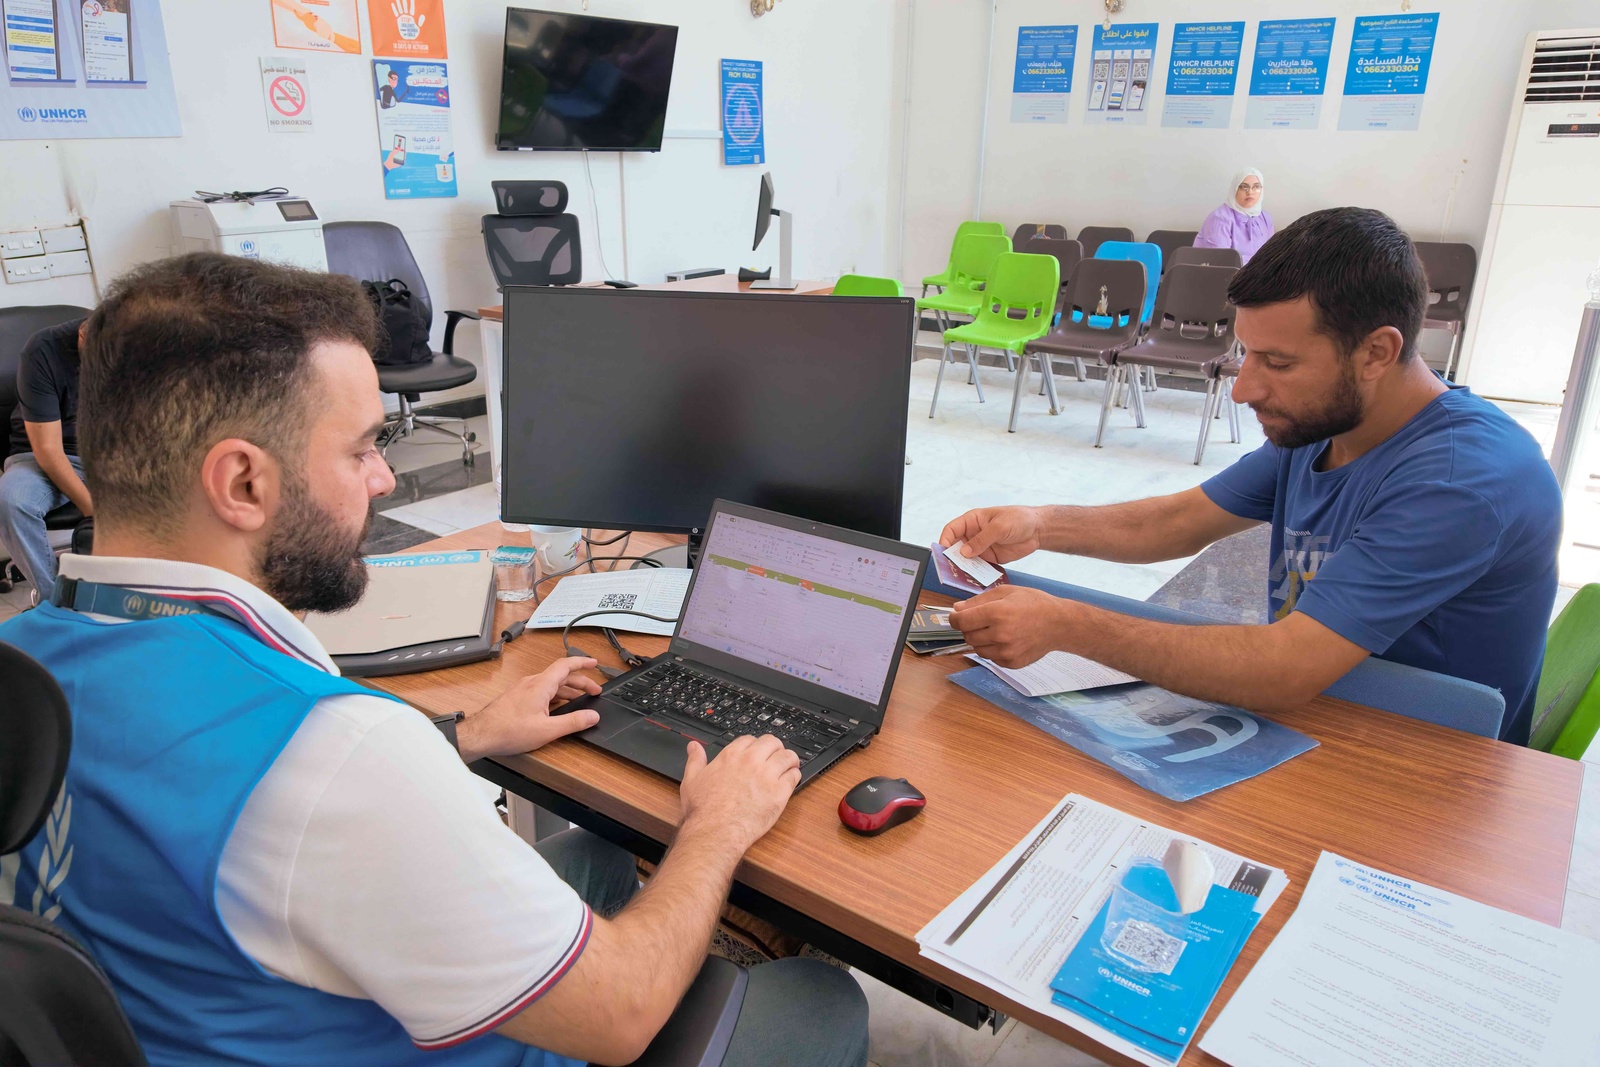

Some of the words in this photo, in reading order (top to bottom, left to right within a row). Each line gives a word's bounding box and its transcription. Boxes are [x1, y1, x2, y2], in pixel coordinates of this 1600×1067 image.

[1102, 30, 1120, 40] اطلاع
[1120, 30, 1132, 38] على
[1133, 30, 1149, 38] ابقوا
[1358, 56, 1402, 65] المساعدة
[1404, 56, 1421, 64] خط
[1363, 64, 1419, 73] 0662330304
[39, 109, 87, 118] UNHCR
[1370, 872, 1411, 889] UNHCR
[1374, 890, 1416, 910] UNHCR
[1113, 974, 1150, 995] UNHCR
